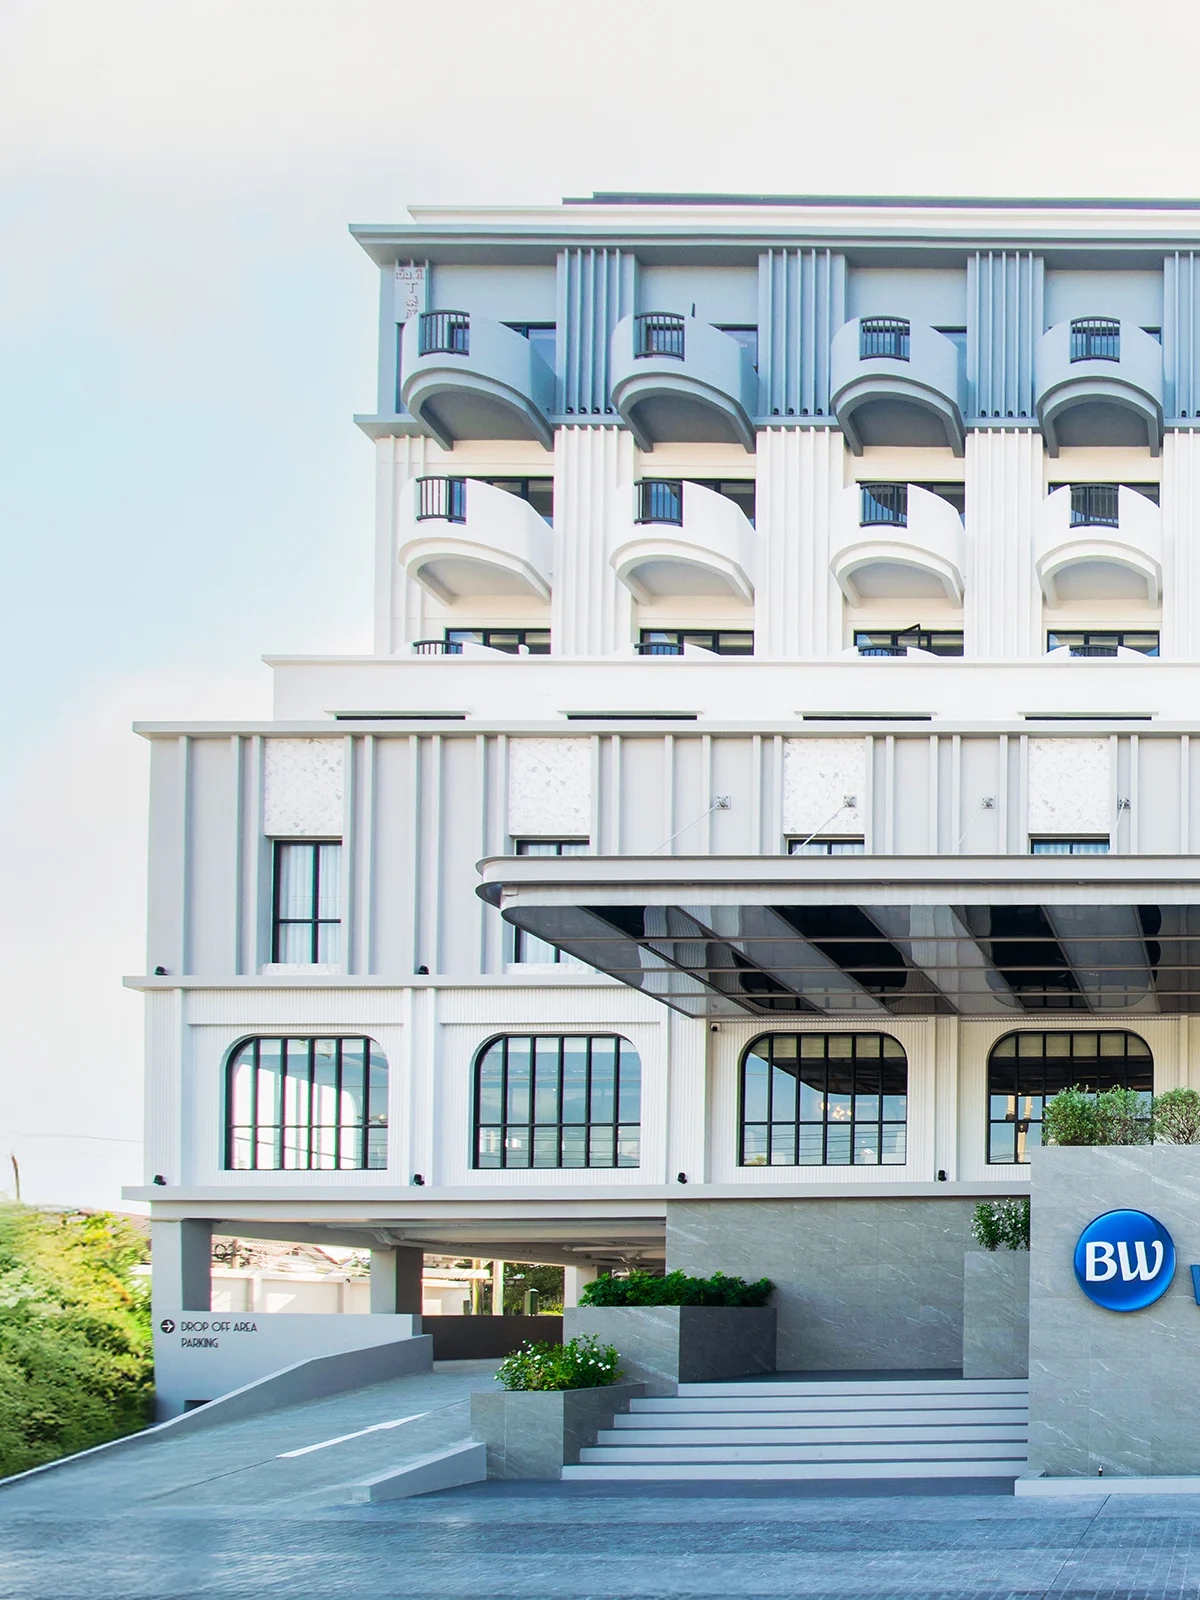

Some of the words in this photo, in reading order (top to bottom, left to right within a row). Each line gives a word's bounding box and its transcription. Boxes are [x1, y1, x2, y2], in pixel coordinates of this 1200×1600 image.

[1085, 1240, 1164, 1282] BW
[181, 1321, 209, 1332] DROP
[211, 1321, 231, 1332] OFF
[233, 1321, 258, 1332] AREA
[181, 1338, 219, 1348] PARKING
